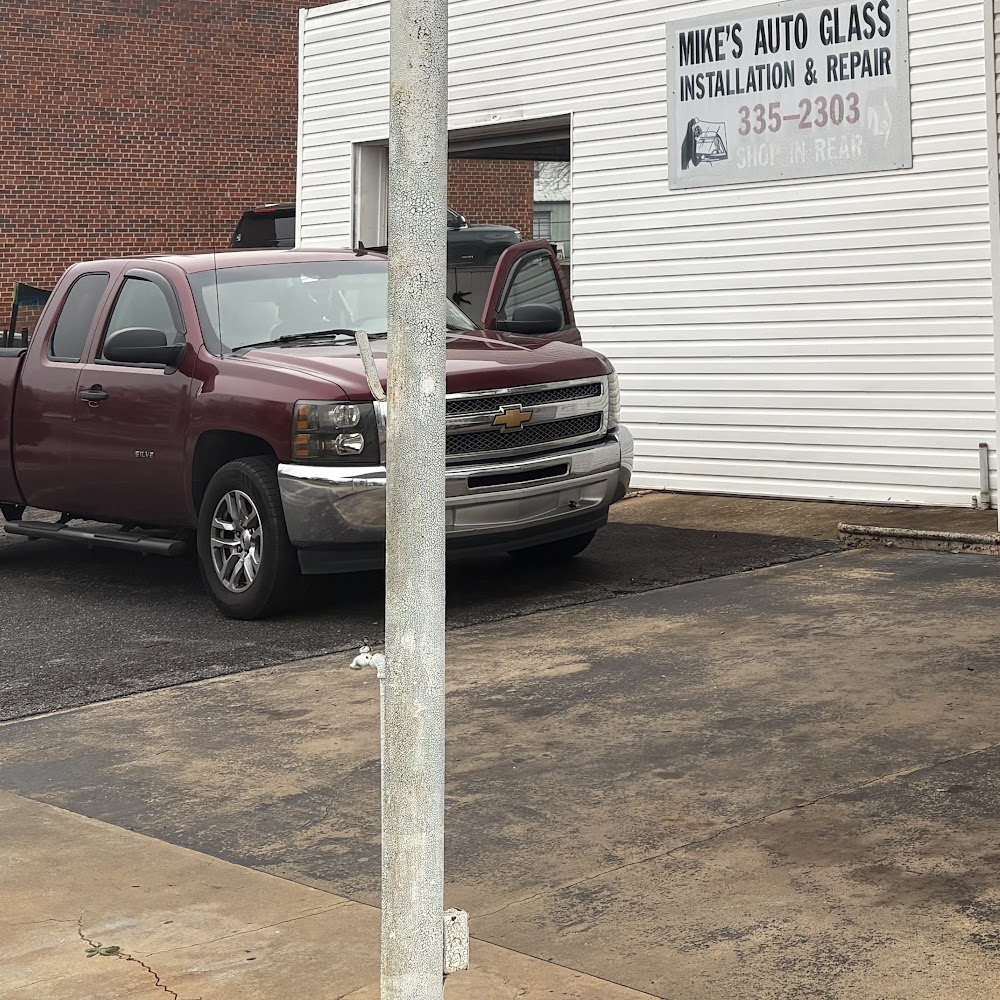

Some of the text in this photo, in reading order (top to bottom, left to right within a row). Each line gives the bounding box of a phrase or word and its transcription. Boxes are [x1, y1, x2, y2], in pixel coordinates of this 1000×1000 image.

[679, 0, 891, 66] MIKE'S AUTO GLASS
[680, 46, 892, 101] INSTALLATION & REPAIR
[815, 134, 864, 163] REAR
